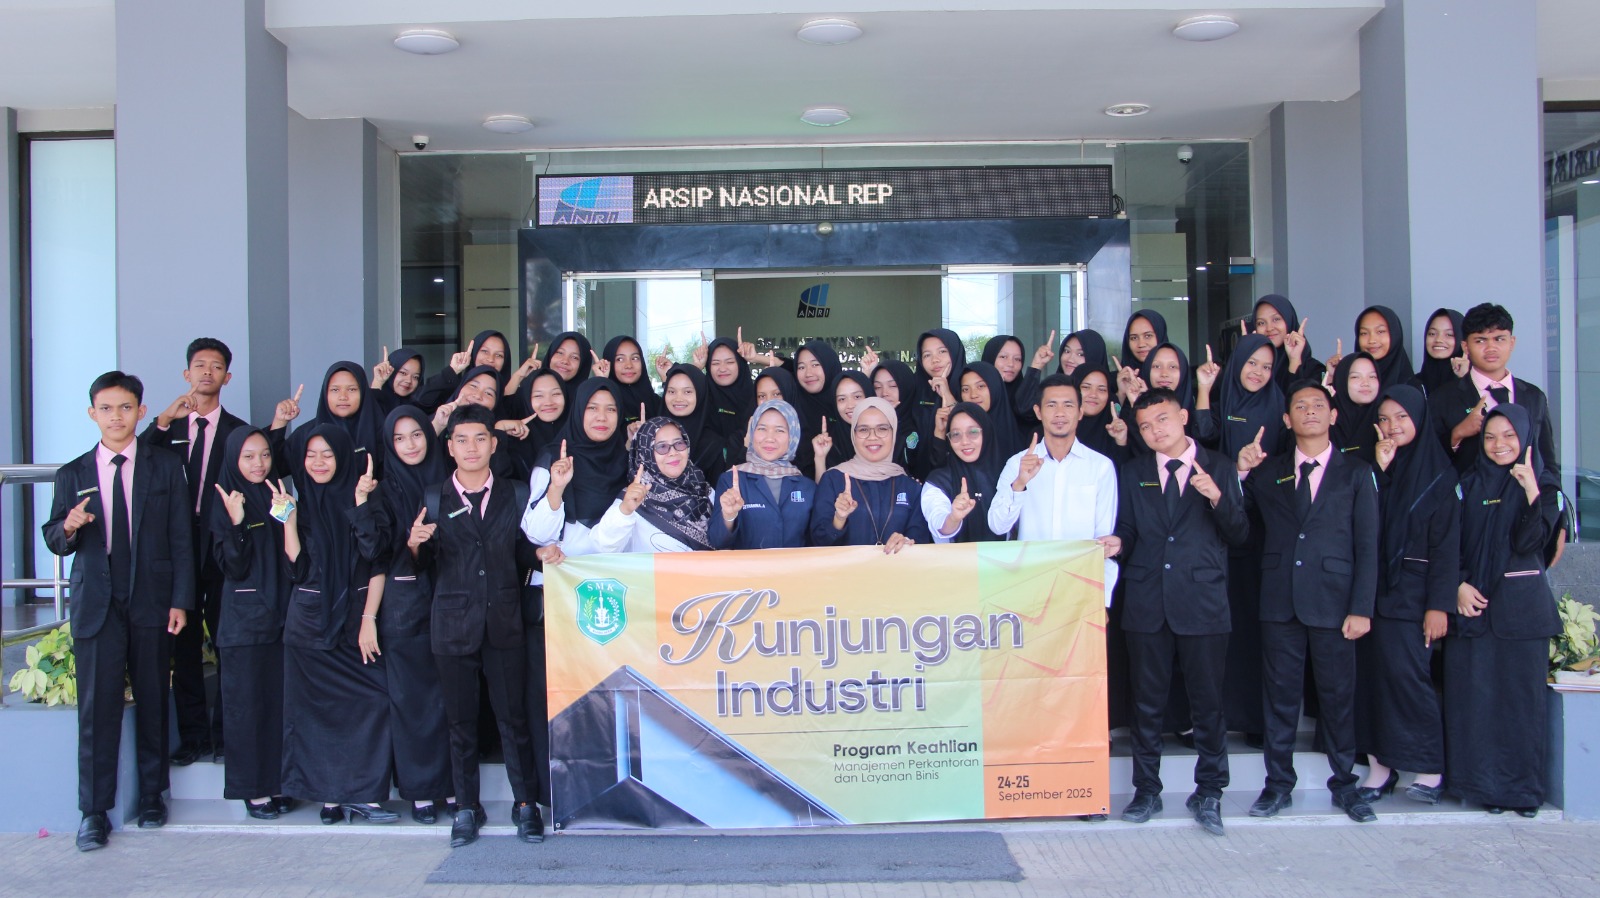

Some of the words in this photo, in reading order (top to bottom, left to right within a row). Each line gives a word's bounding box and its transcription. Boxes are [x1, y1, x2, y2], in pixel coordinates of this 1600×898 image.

[643, 187, 713, 209] ARSIP
[719, 184, 842, 207] NASIONAL
[848, 183, 893, 205] REP
[555, 212, 618, 225] ANRI
[798, 309, 830, 318] ANRI
[586, 582, 614, 592] SMK
[659, 588, 1024, 668] Kunjungan
[715, 664, 927, 717] Industri
[833, 743, 902, 759] Program
[907, 740, 978, 755] Keahlian
[834, 760, 905, 773] Manajemen
[908, 757, 980, 769] Perkantoran
[834, 773, 858, 784] dan
[861, 771, 913, 784] Layanan
[915, 769, 940, 781] Binis
[997, 775, 1030, 789] 24-25
[998, 789, 1064, 803] September
[1066, 788, 1093, 799] 2025
